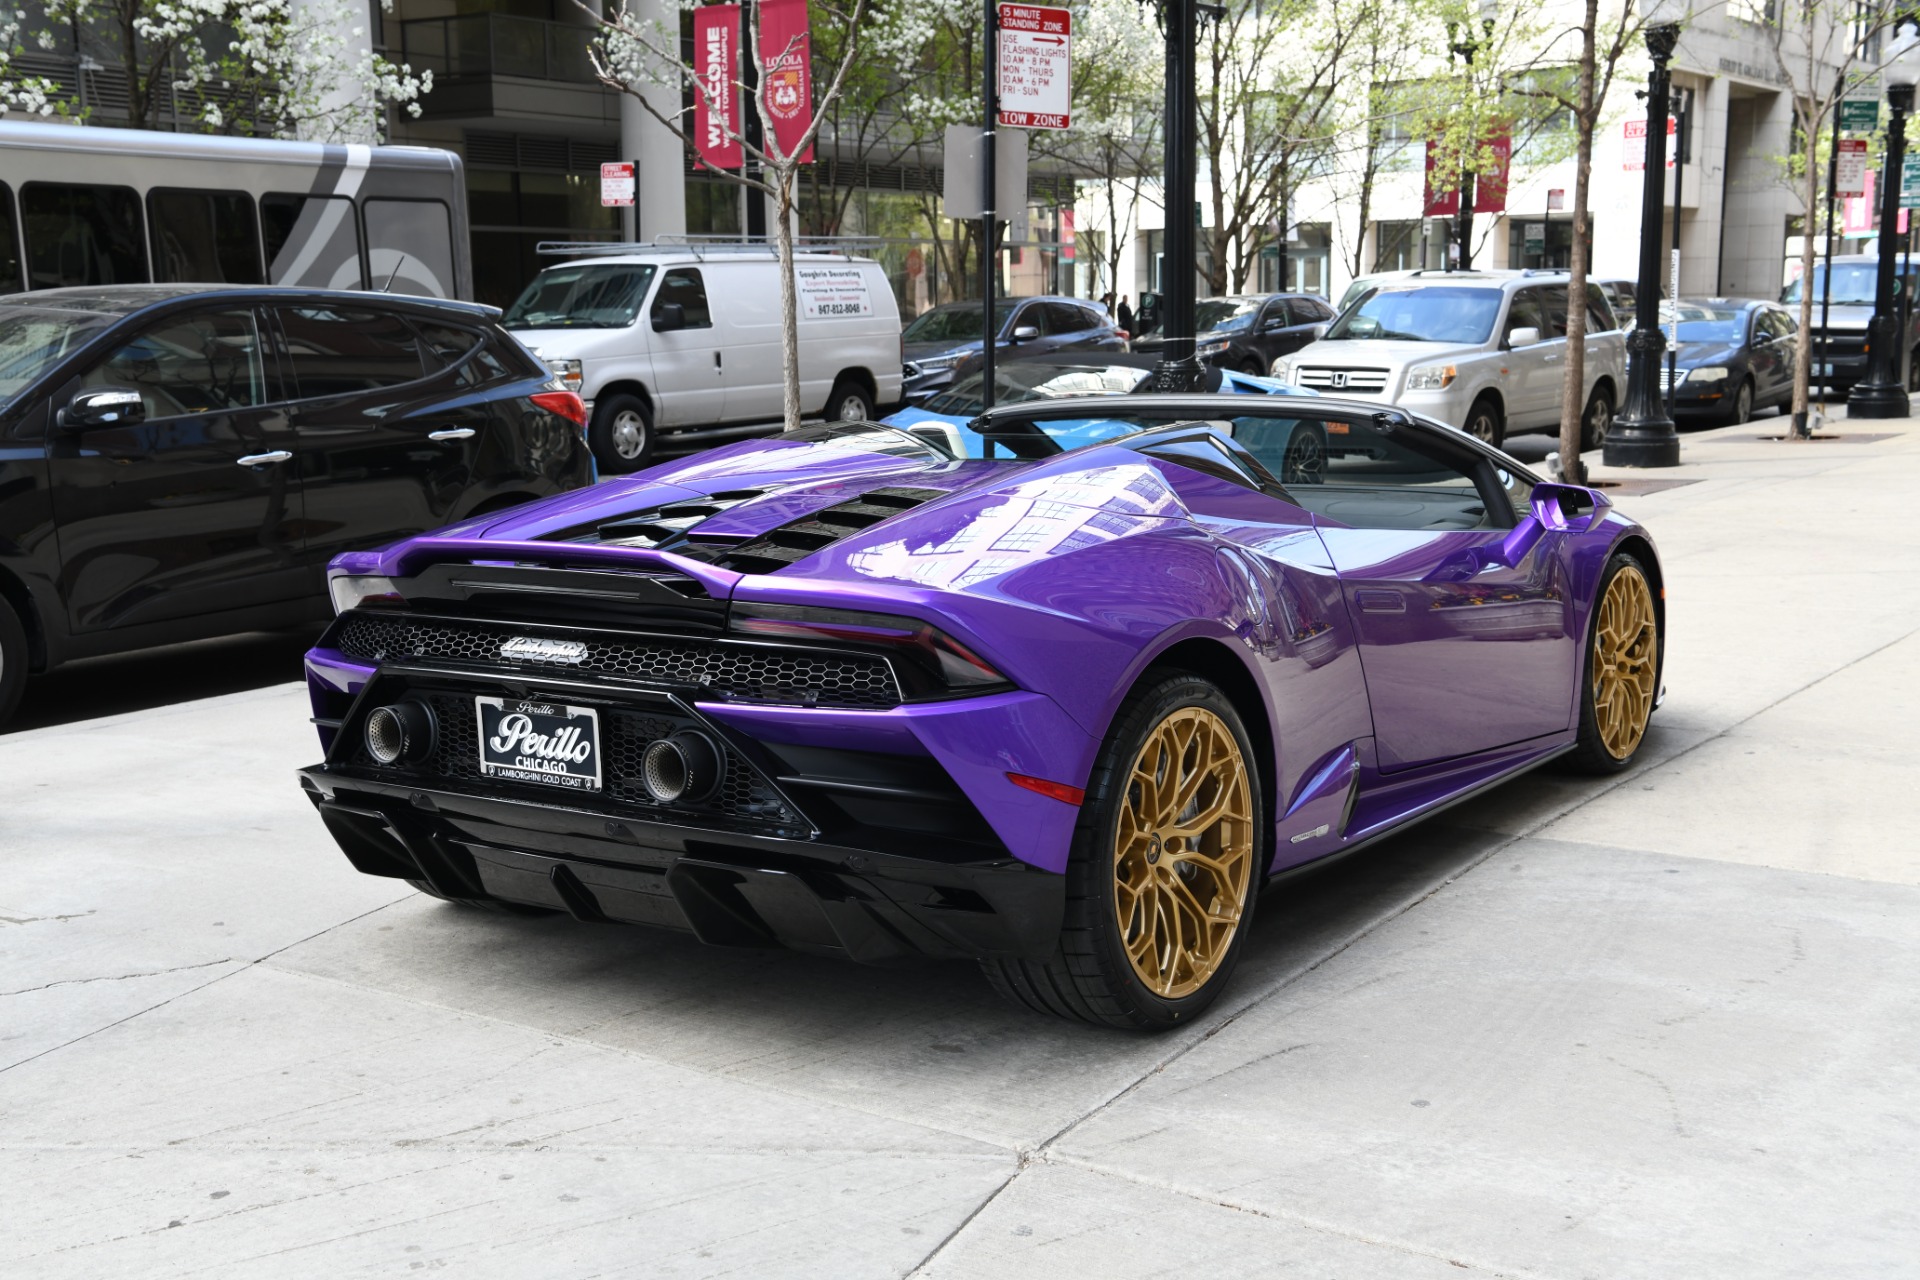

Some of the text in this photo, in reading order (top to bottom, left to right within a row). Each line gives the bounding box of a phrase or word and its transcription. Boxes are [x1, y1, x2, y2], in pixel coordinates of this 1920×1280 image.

[1003, 7, 1041, 19] 15 MINUTE
[1003, 18, 1063, 32] STANDING ZONE
[1003, 34, 1018, 43] USE
[721, 27, 729, 72] CAMPUS
[1003, 45, 1066, 58] FLASHING LIGHTS
[765, 54, 803, 67] LOOLA
[1003, 55, 1011, 63] 10
[1013, 55, 1024, 64] AM
[1032, 57, 1037, 65] 8
[1040, 58, 1050, 66] PM
[1003, 65, 1019, 74] MON
[1029, 67, 1054, 77] THURS
[1003, 75, 1011, 83] 10
[1012, 76, 1023, 84] AM
[1032, 78, 1037, 86] 6
[1038, 78, 1049, 86] PM
[707, 27, 721, 148] WELCOME
[721, 74, 729, 111] TOWER
[1003, 85, 1015, 94] FRI
[1023, 87, 1039, 96] SUN
[1003, 112, 1064, 127] TOW ZONE
[828, 270, 861, 279] Decorating
[818, 303, 861, 314] 847-812-8048
[516, 701, 555, 715] Perillo
[490, 713, 591, 764] Perillo
[515, 756, 567, 773] CHICAGO
[498, 768, 581, 787] LAMBORGHINI GOLD COAST
